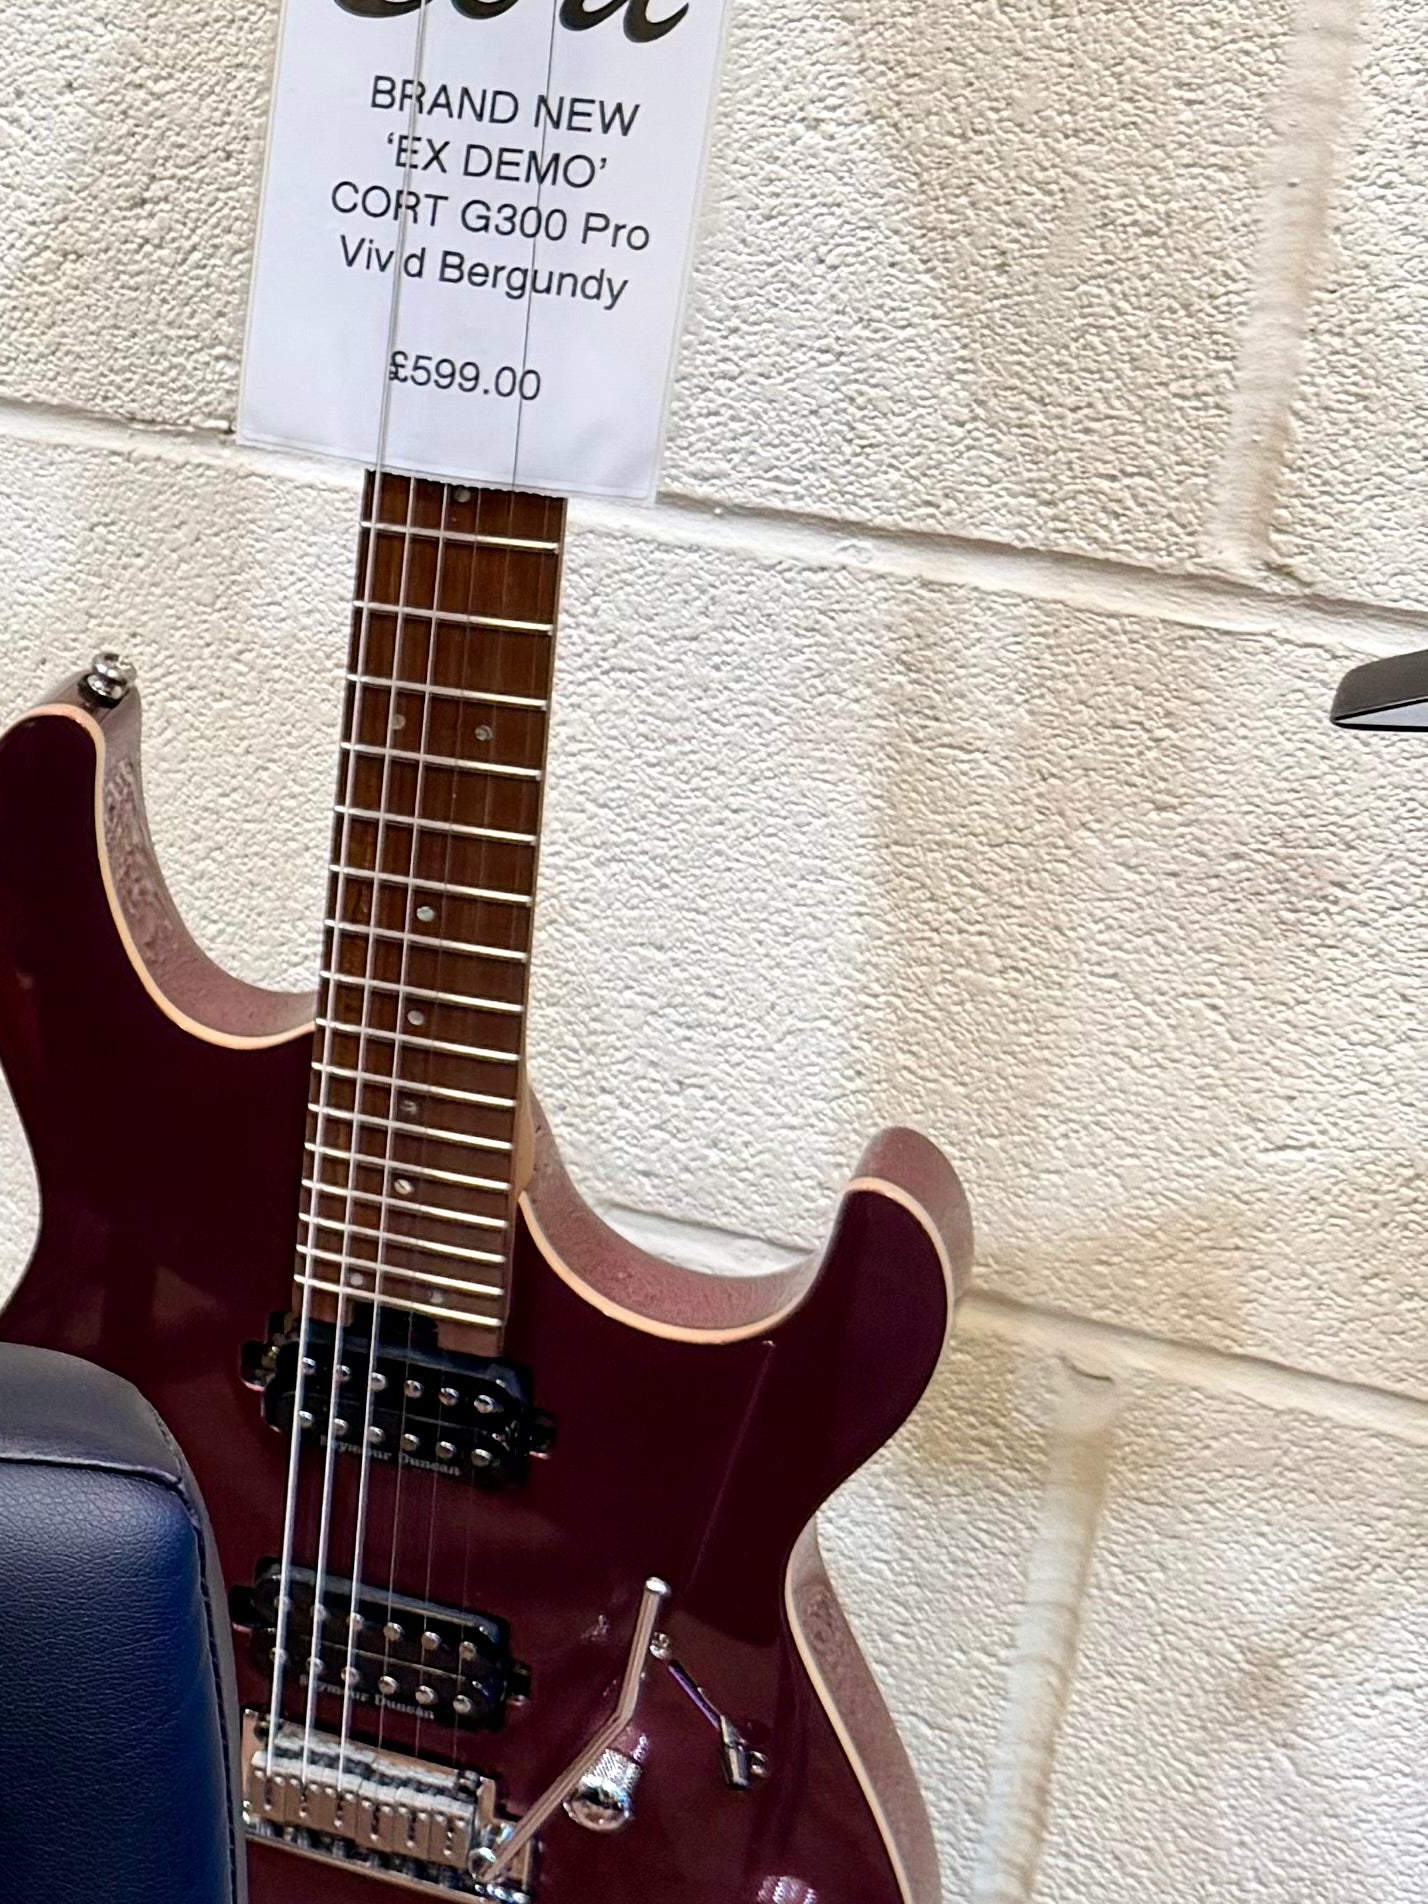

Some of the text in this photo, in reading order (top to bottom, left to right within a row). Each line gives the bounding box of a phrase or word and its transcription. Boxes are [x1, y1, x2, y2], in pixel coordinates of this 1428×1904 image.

[370, 74, 641, 137] BRAND NEW
[331, 181, 651, 251] CORT G300 Pro
[340, 234, 629, 311] Vivd Bergundy
[388, 350, 542, 401] £599.00
